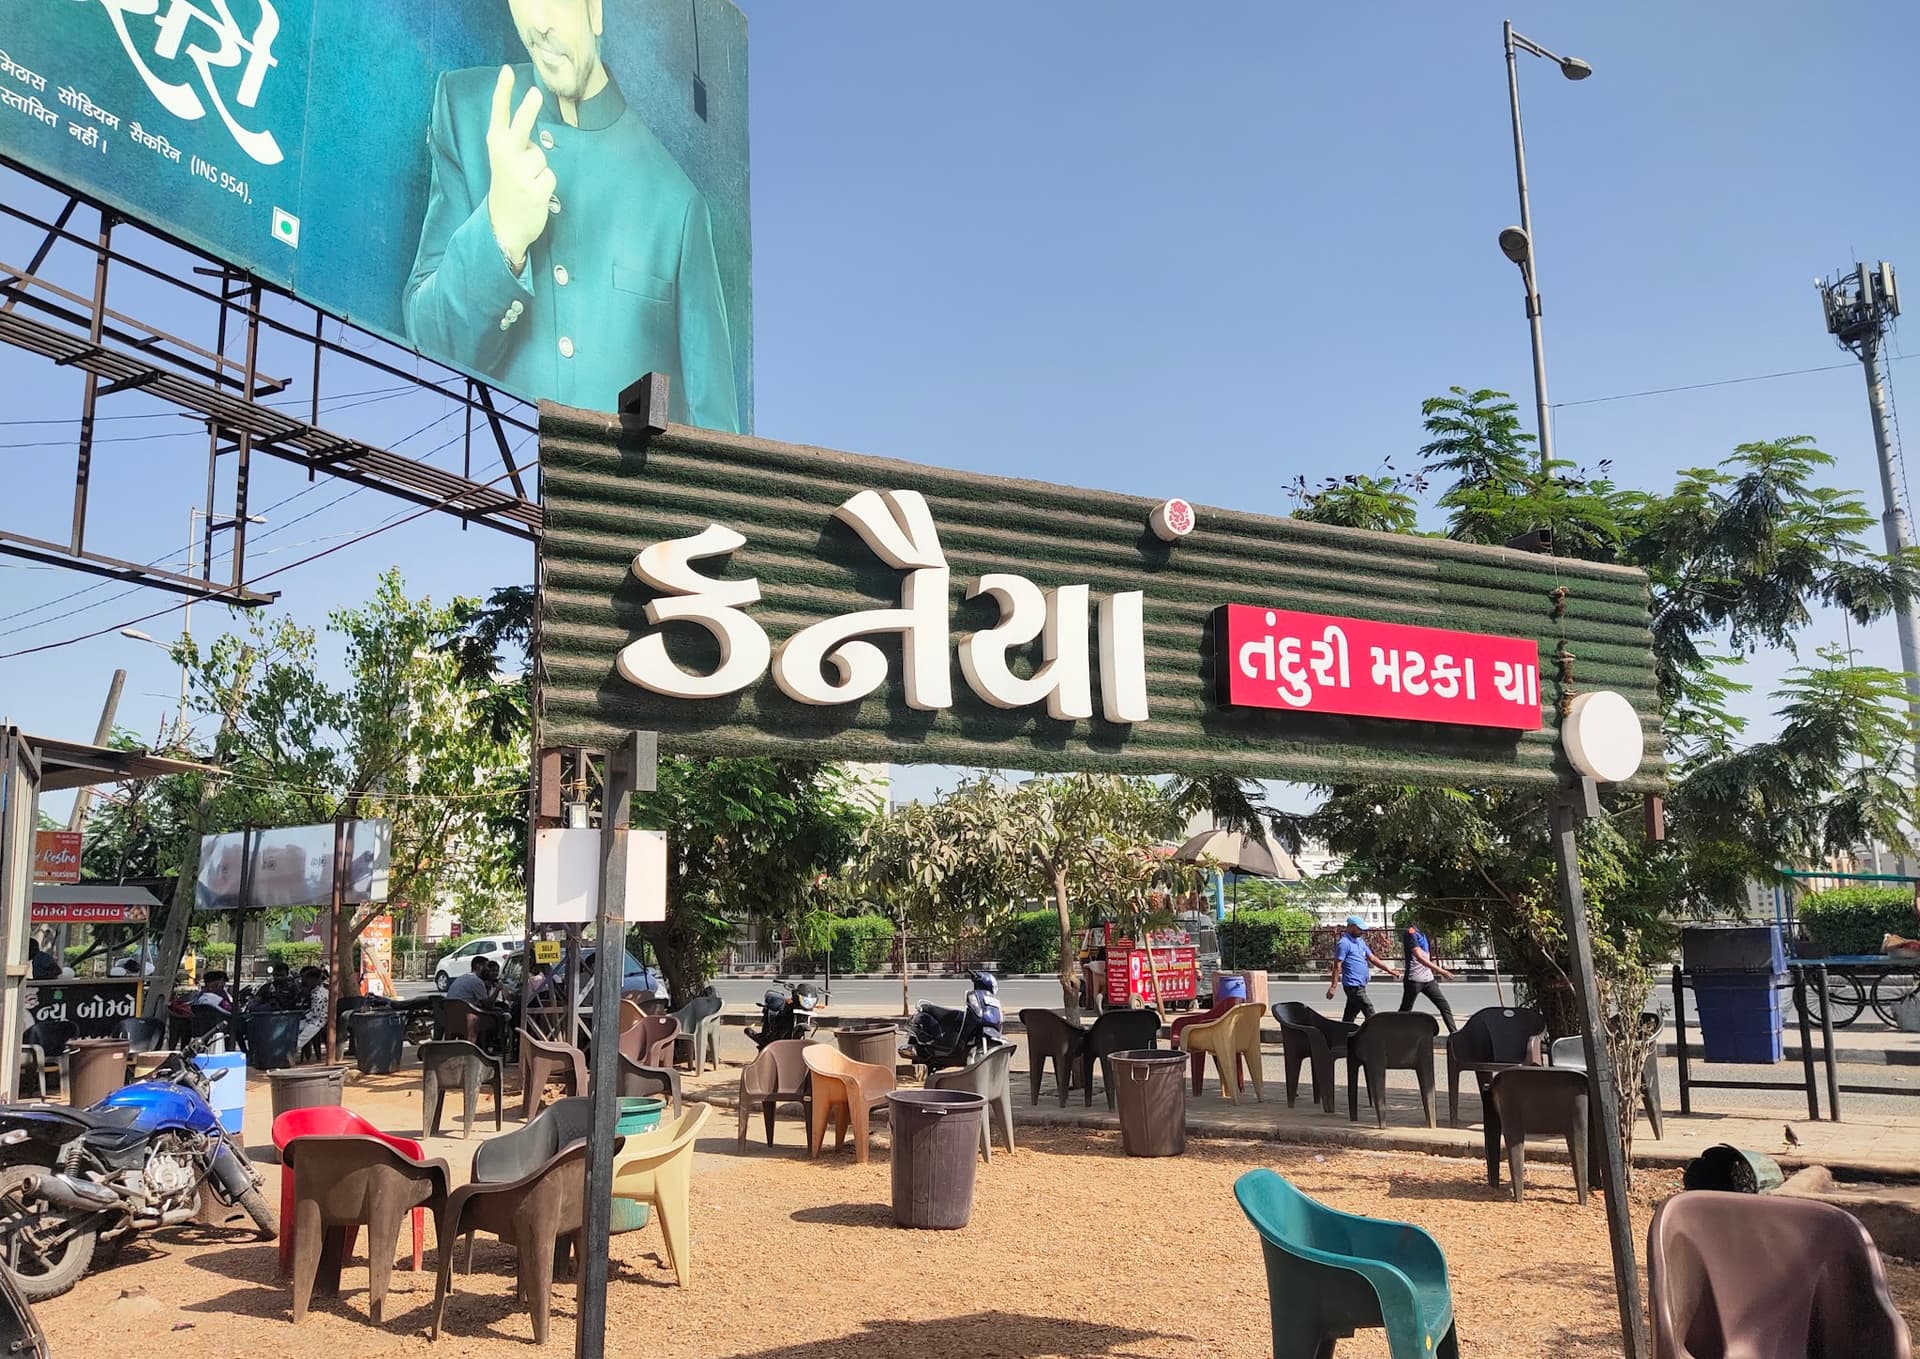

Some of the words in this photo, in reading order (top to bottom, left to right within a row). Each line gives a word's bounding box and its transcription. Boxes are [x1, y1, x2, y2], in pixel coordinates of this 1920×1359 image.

[0, 85, 59, 128] स्तावित
[74, 0, 284, 165] सरी
[57, 86, 121, 131] सोडियम
[129, 122, 182, 164] सैकरिन
[190, 154, 219, 184] (INS
[220, 172, 254, 205] 954),
[616, 489, 1150, 724] કનૈયા
[1239, 612, 1352, 707] તંદુરી
[1371, 646, 1477, 700] મટકા
[76, 993, 136, 1019] બોમ્બે
